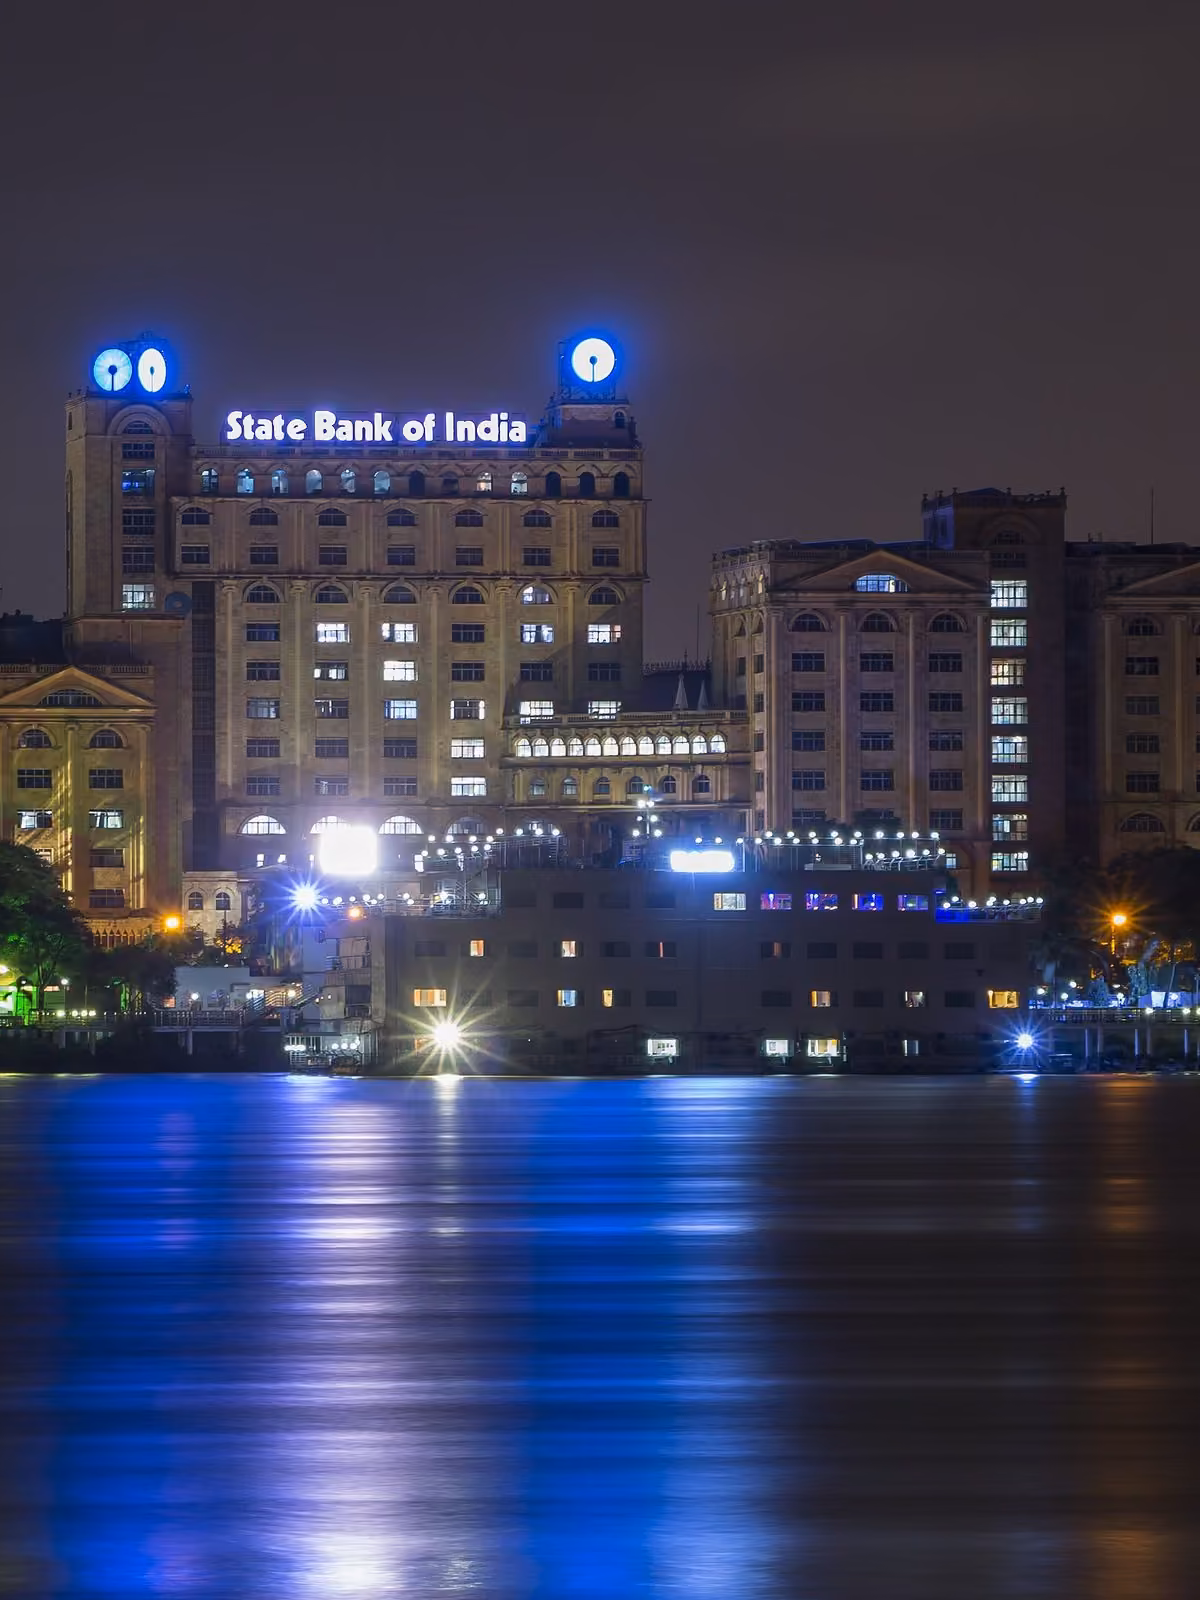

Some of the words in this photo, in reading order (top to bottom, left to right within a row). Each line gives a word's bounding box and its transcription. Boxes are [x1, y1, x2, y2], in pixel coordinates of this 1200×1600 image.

[227, 410, 307, 440] State
[314, 410, 393, 441] Bank
[402, 413, 436, 441] of
[445, 411, 526, 442] India
